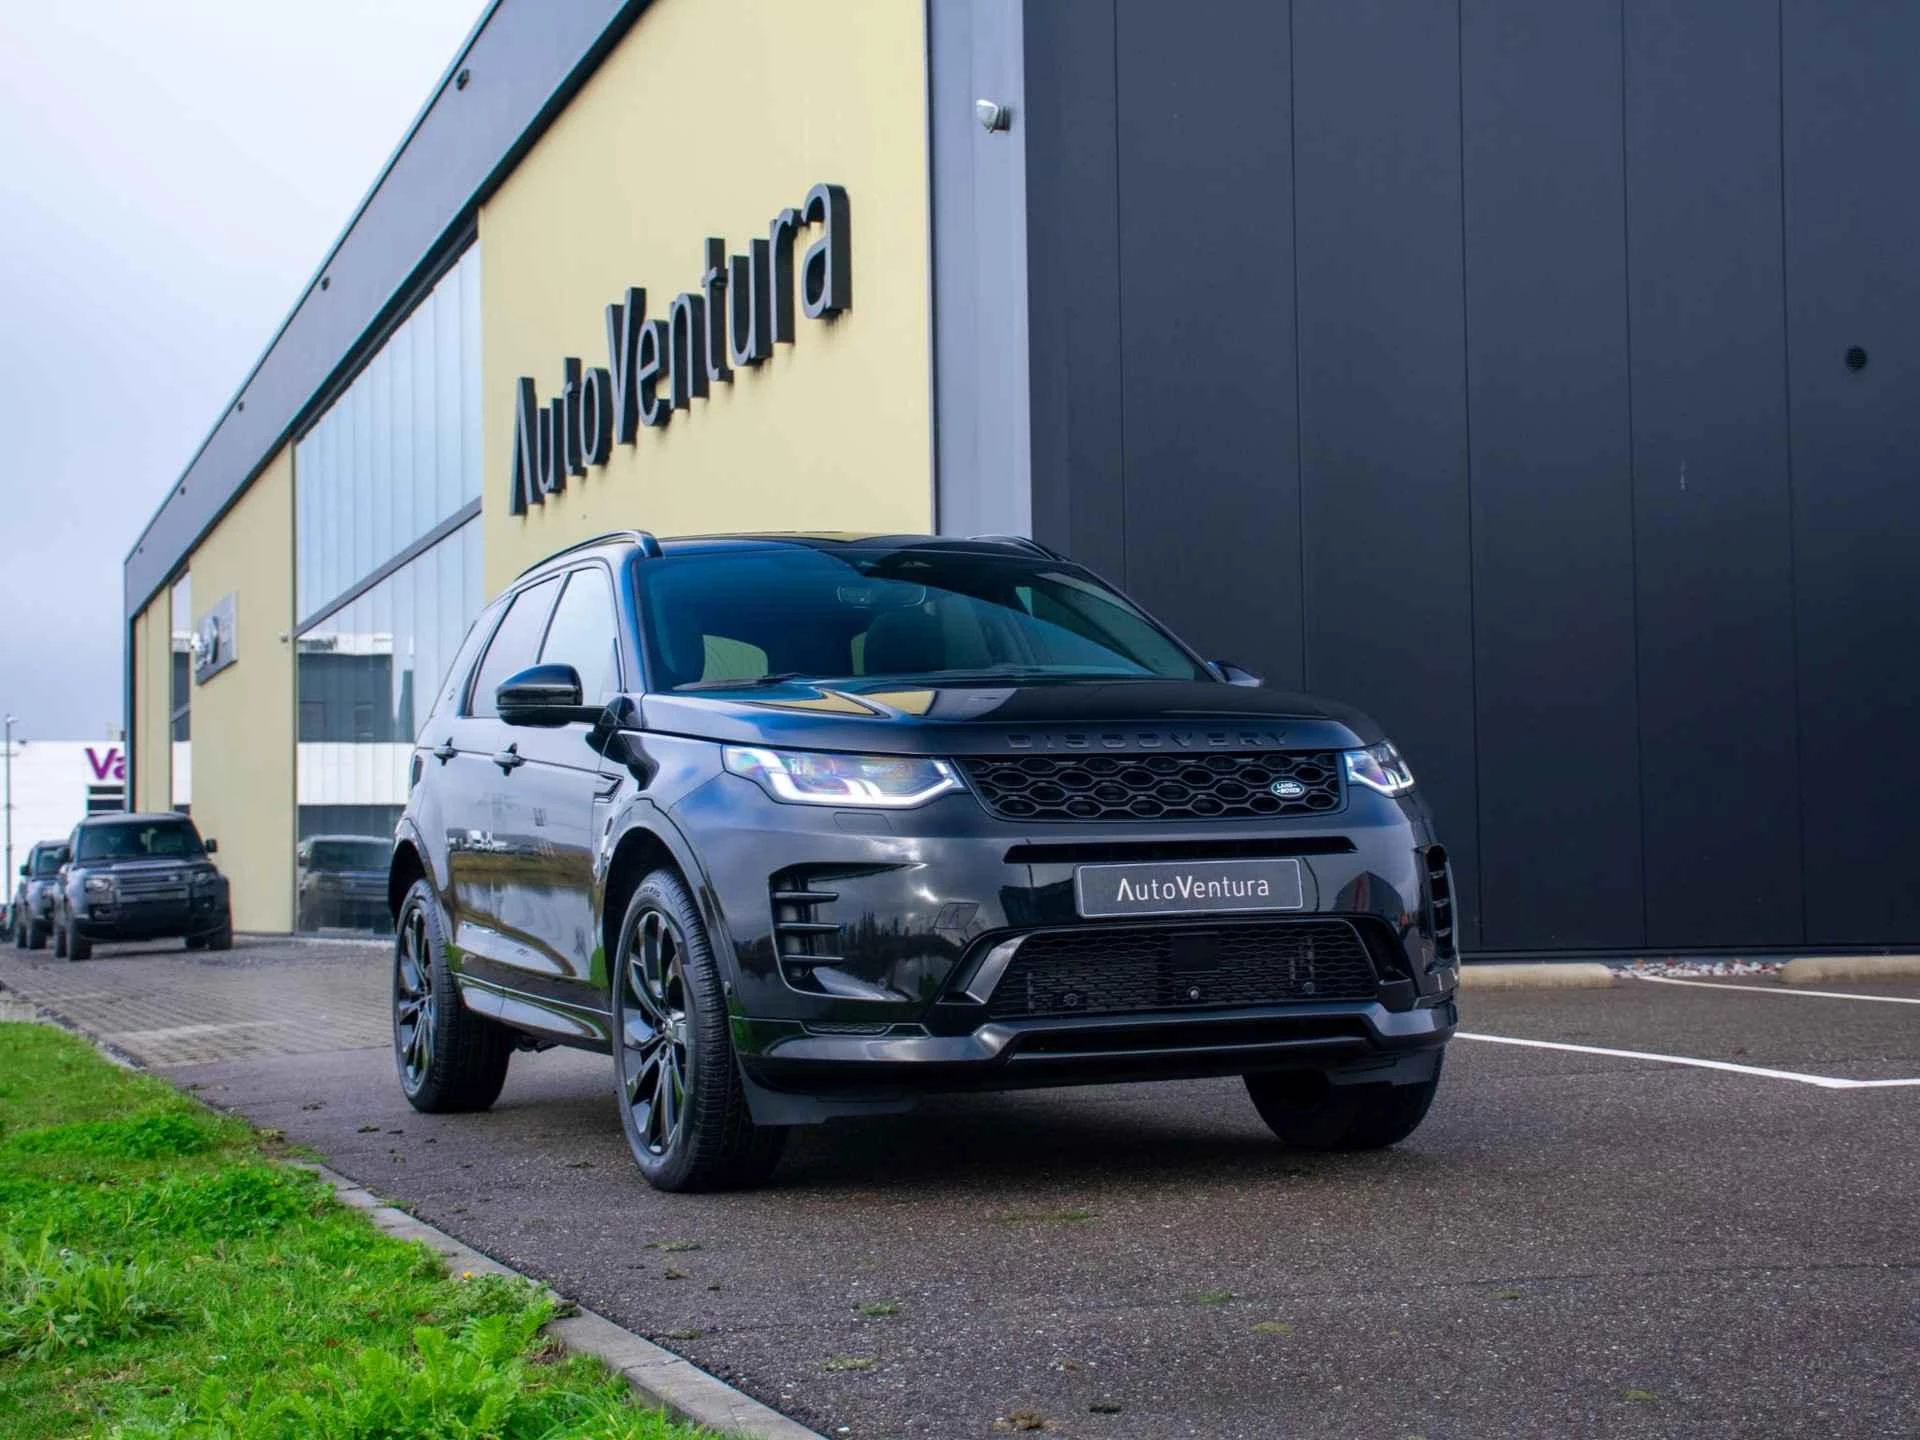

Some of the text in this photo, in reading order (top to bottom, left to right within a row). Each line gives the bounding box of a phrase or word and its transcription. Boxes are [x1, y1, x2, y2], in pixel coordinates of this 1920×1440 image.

[509, 183, 852, 516] AutoVentura
[1007, 731, 1288, 749] DISCOVERY
[1116, 875, 1270, 901] AutoVentura
